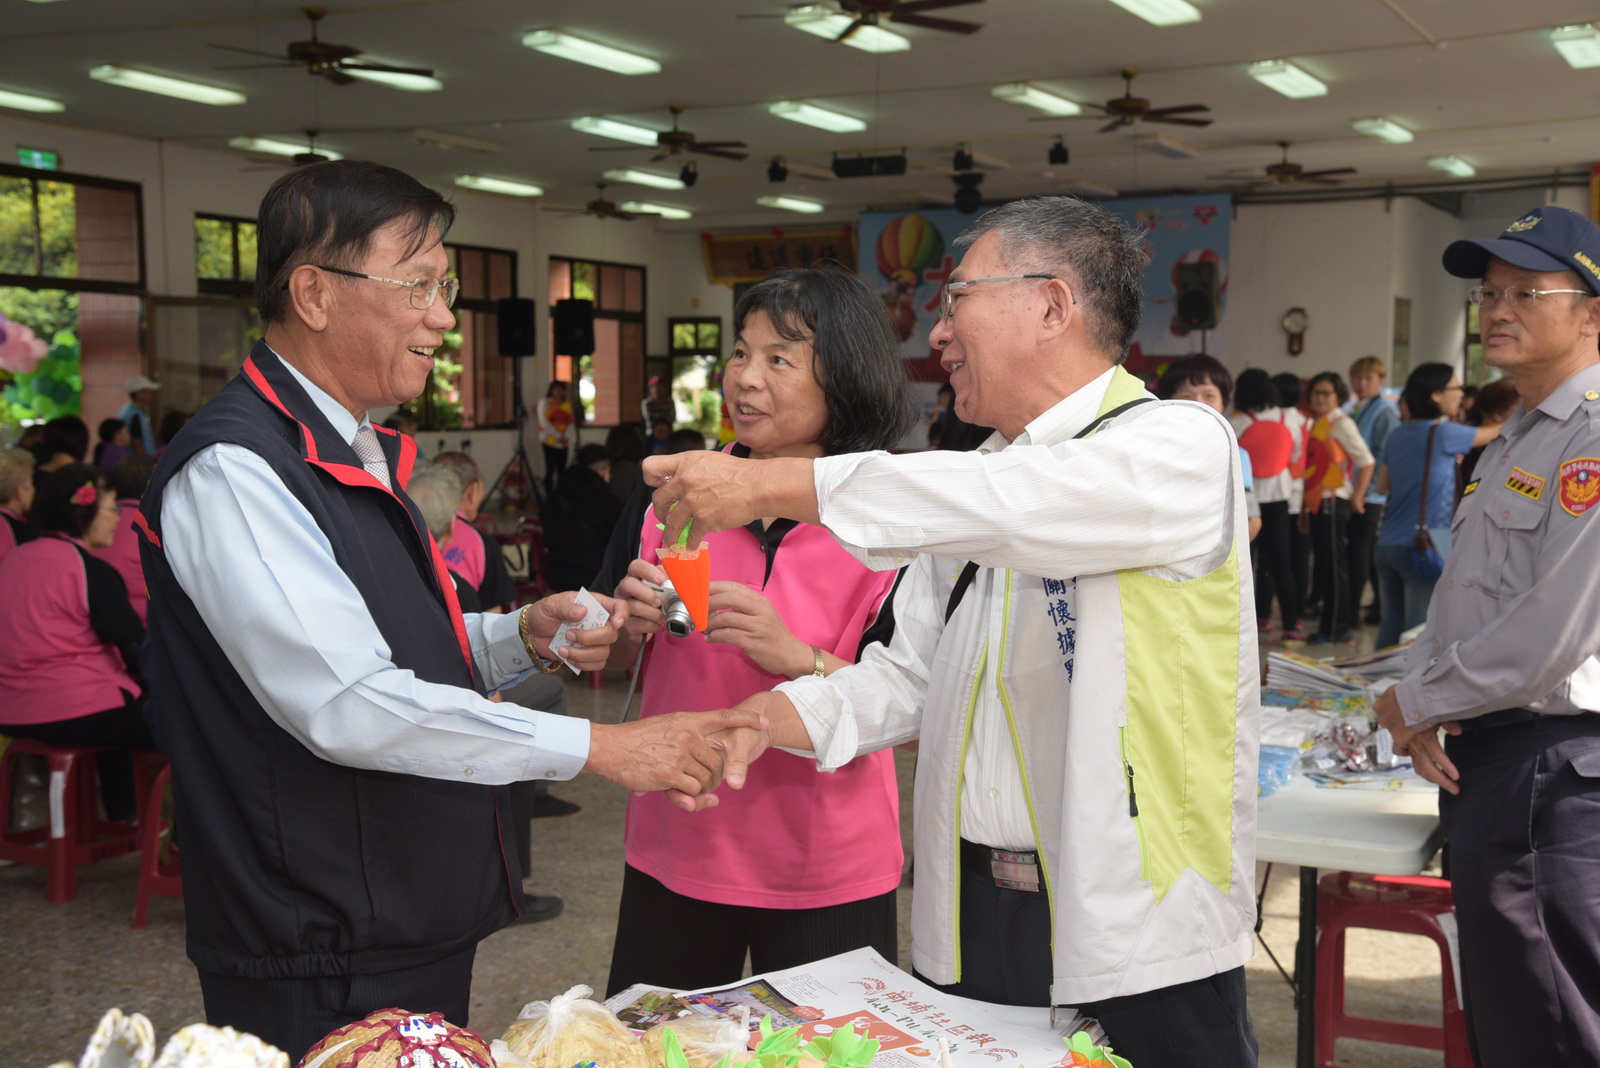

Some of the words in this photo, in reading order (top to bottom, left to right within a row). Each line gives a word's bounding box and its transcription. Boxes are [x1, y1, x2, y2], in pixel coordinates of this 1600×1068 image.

[880, 990, 997, 1048] 南埔社區報
